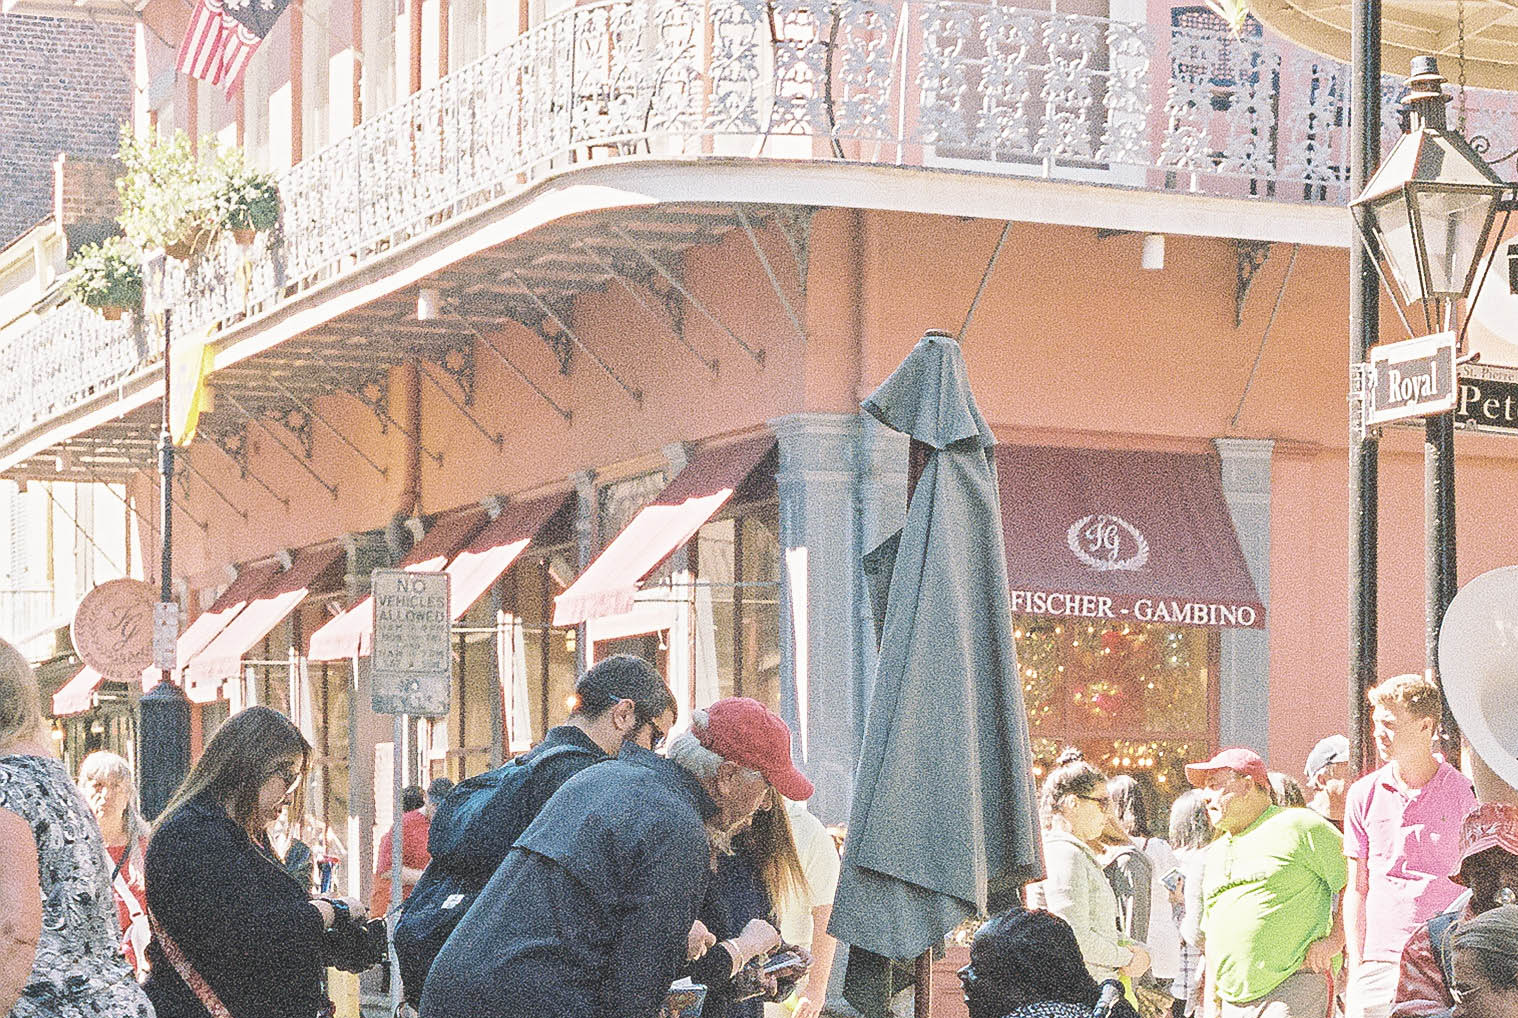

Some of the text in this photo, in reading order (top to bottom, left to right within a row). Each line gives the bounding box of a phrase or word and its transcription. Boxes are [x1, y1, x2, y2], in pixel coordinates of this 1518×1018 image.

[1389, 361, 1438, 403] Royal
[397, 579, 427, 594] NO
[379, 595, 445, 608] VEHICLES
[1010, 591, 1115, 618] FISCHER
[1133, 599, 1256, 626] GAMBINO
[379, 610, 444, 623] ALLOWED
